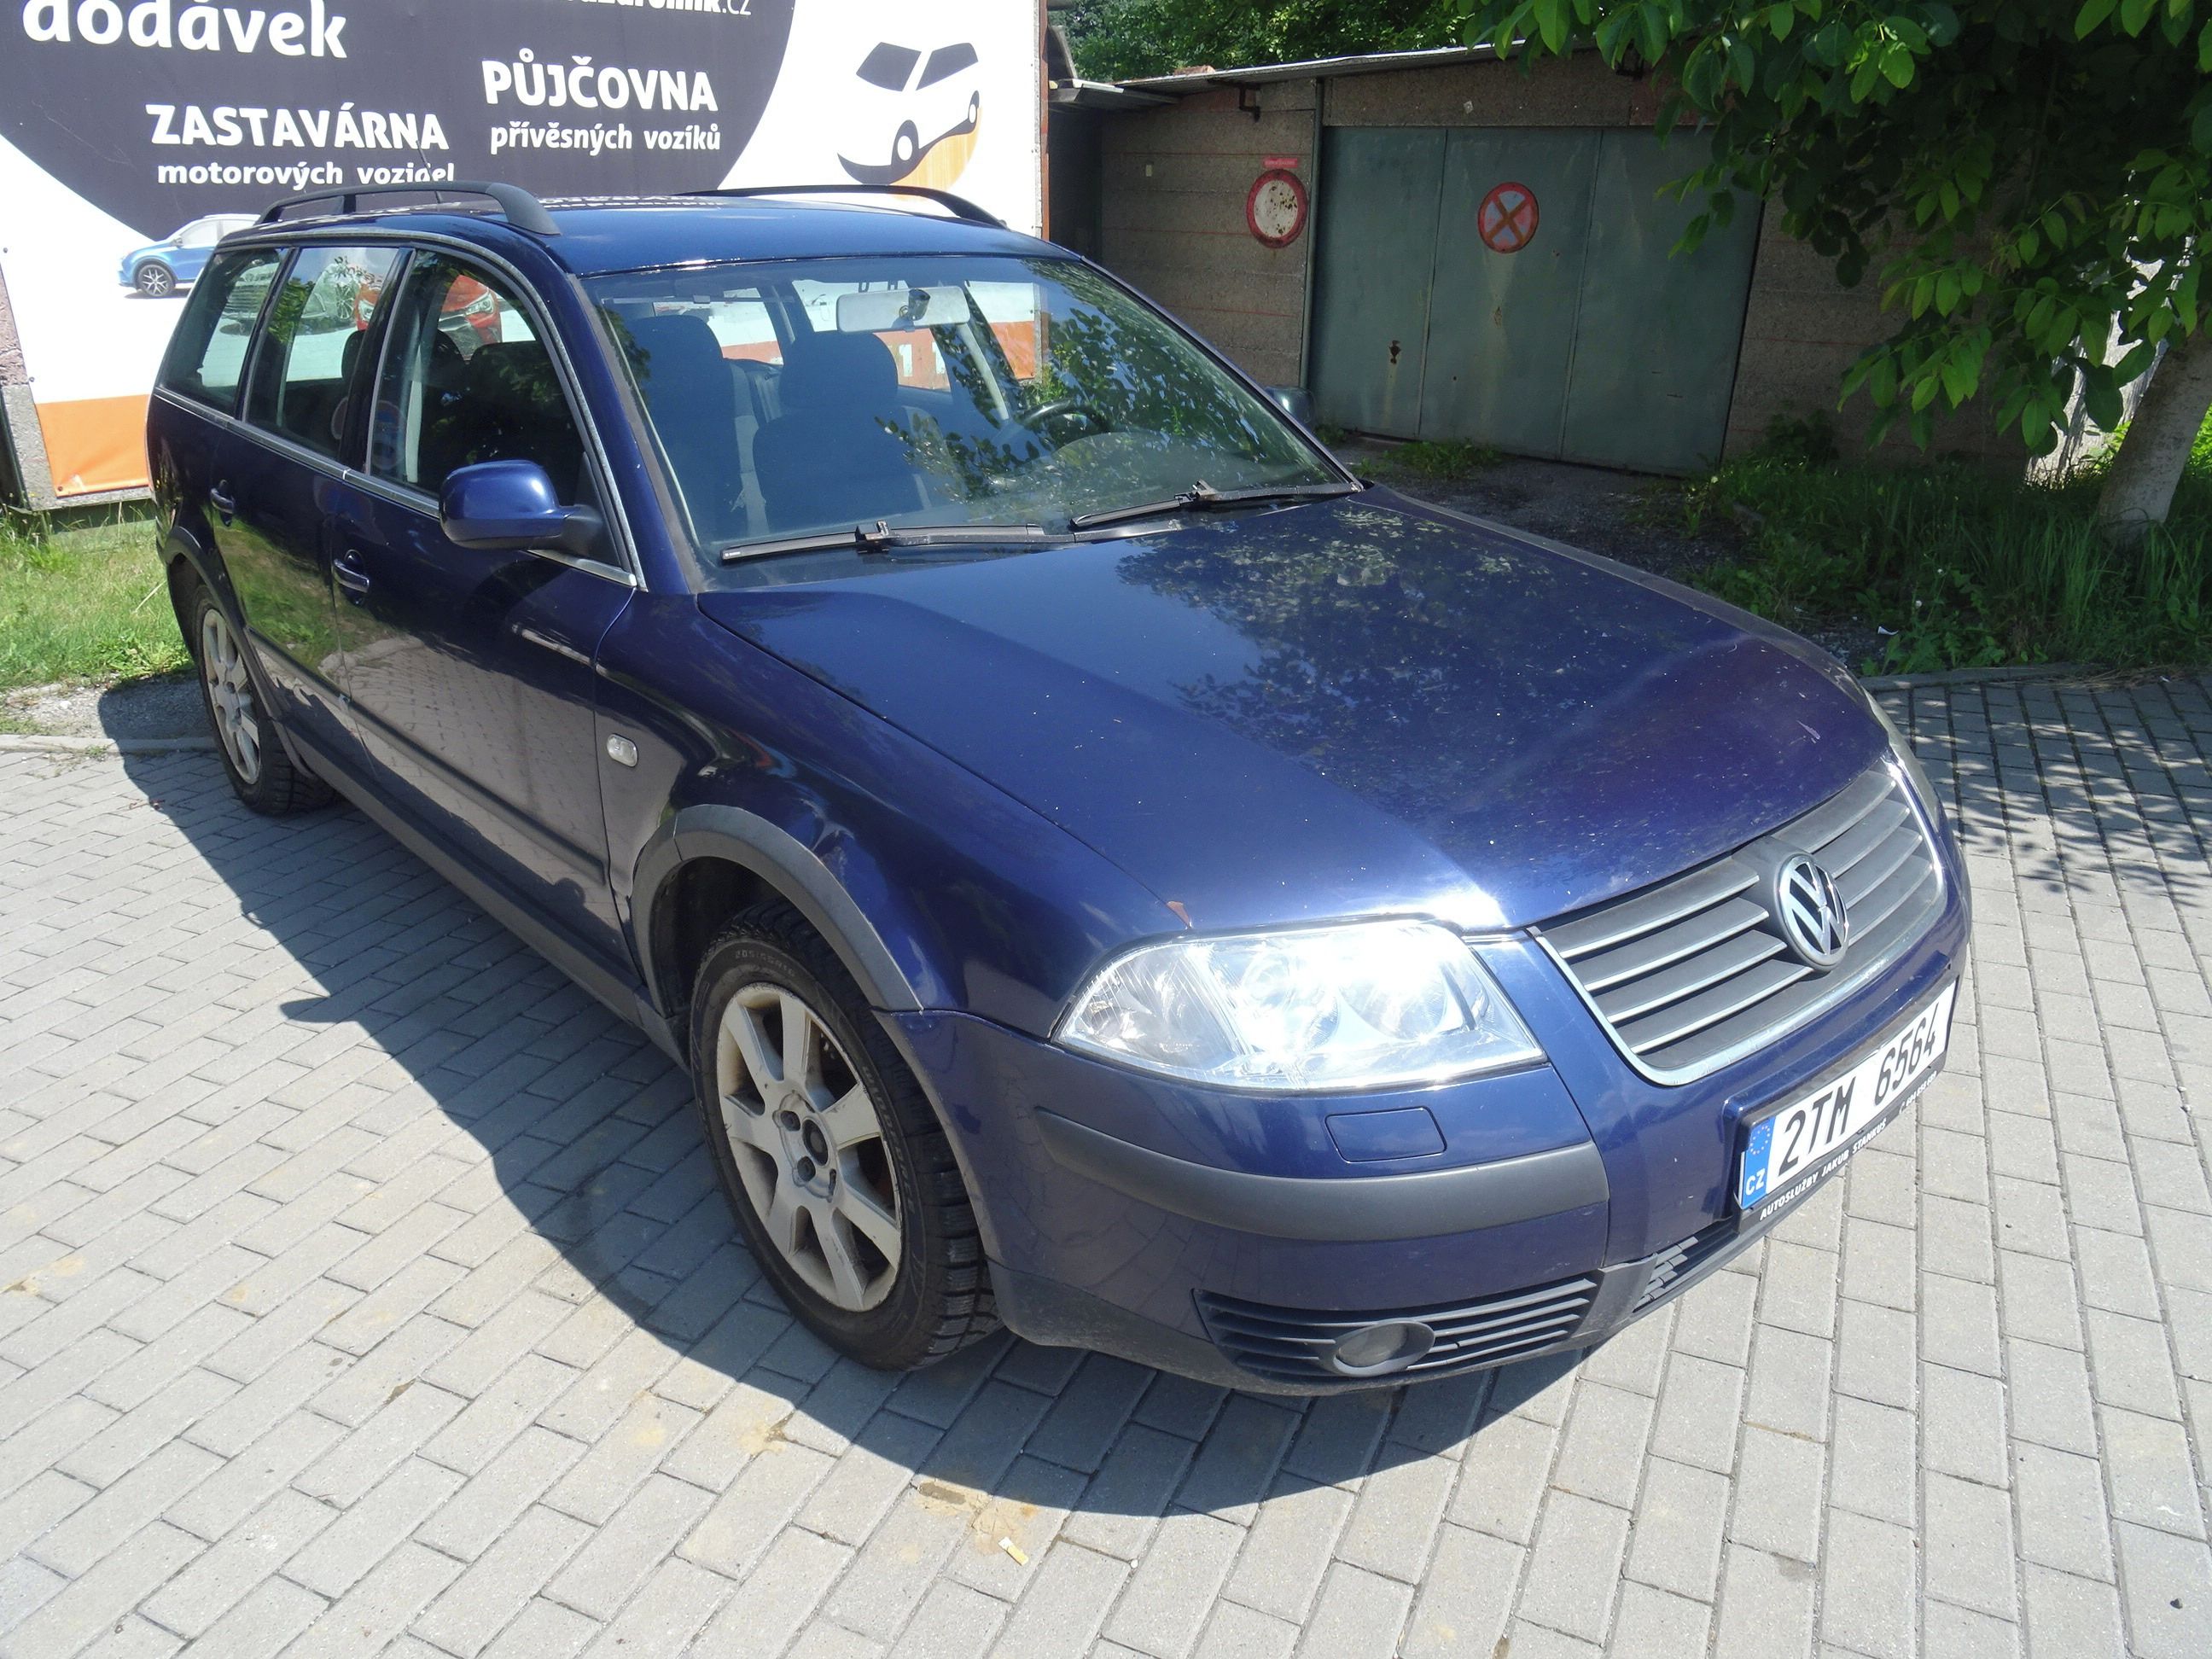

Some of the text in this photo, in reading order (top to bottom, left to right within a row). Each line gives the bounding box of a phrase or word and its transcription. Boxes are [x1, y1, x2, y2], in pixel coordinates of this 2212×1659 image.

[481, 48, 719, 112] PŮJČOVNA
[145, 102, 450, 150] ZASTAVÁRNA
[491, 120, 720, 156] přívěsných vozíků
[158, 161, 455, 190] motorových vozidel
[1778, 1076, 1857, 1178] 2TM
[1874, 1002, 1940, 1107] 6564
[1745, 1167, 1767, 1196] CZ
[1759, 1173, 1819, 1221] AUTOSLUŽBY
[1821, 1148, 1850, 1178] JAKUB
